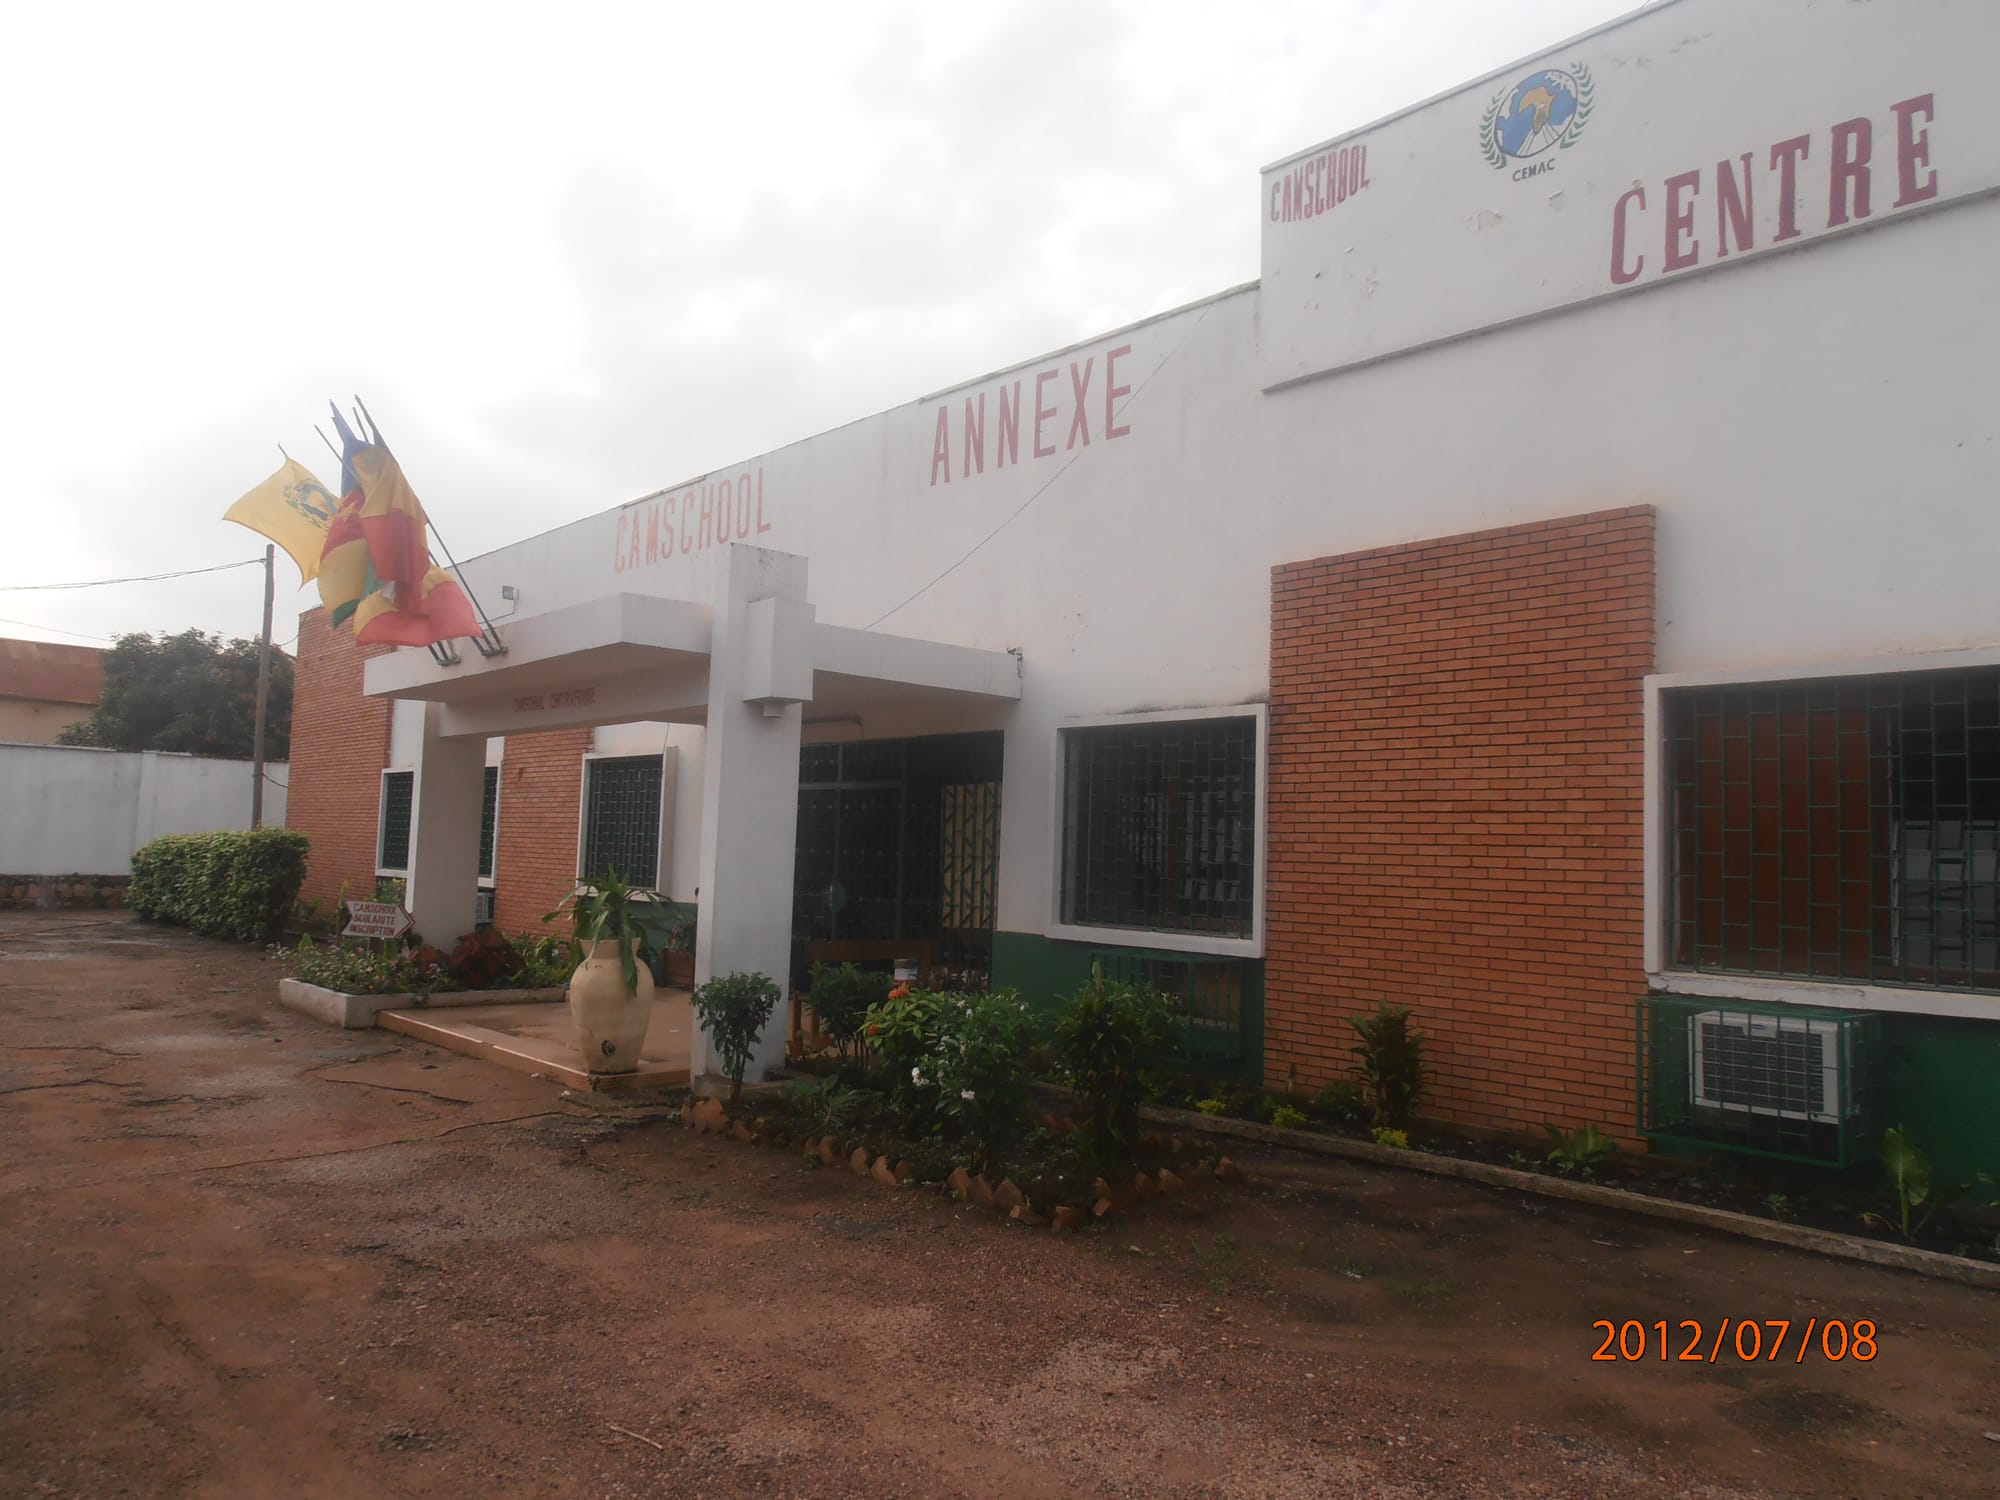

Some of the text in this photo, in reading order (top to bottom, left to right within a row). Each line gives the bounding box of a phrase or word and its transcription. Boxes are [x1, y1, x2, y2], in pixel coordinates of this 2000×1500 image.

[1270, 144, 1370, 223] CAMSCHOOL
[1511, 157, 1556, 182] CEMAC
[1609, 93, 1938, 285] CENTRE
[930, 344, 1132, 486] ANNEXE
[613, 467, 772, 574] CAMSCHOOL
[350, 924, 396, 937] INSCRIPTION
